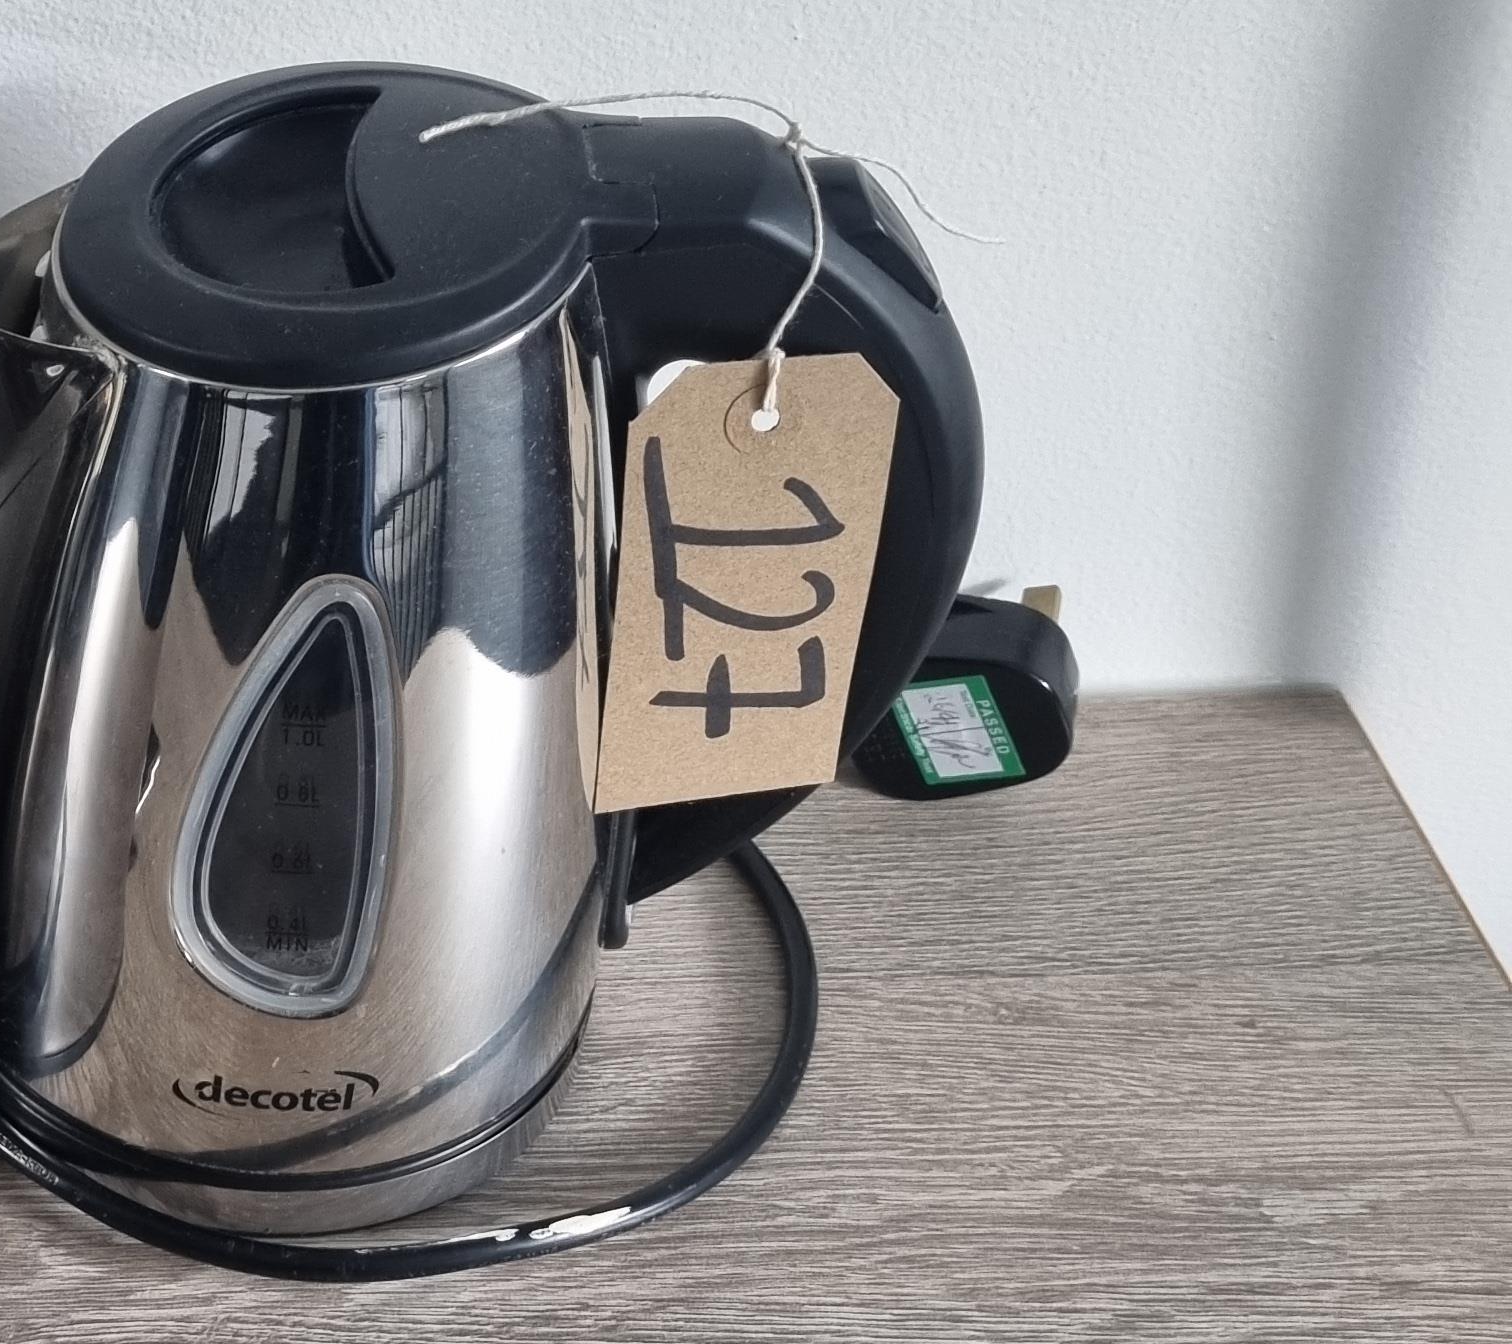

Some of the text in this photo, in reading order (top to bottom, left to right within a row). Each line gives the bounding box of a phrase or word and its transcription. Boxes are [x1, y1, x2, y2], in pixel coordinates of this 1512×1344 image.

[643, 436, 845, 739] 127
[975, 699, 1010, 754] PASSED
[266, 936, 308, 952] MIN
[194, 1074, 356, 1112] decotel
